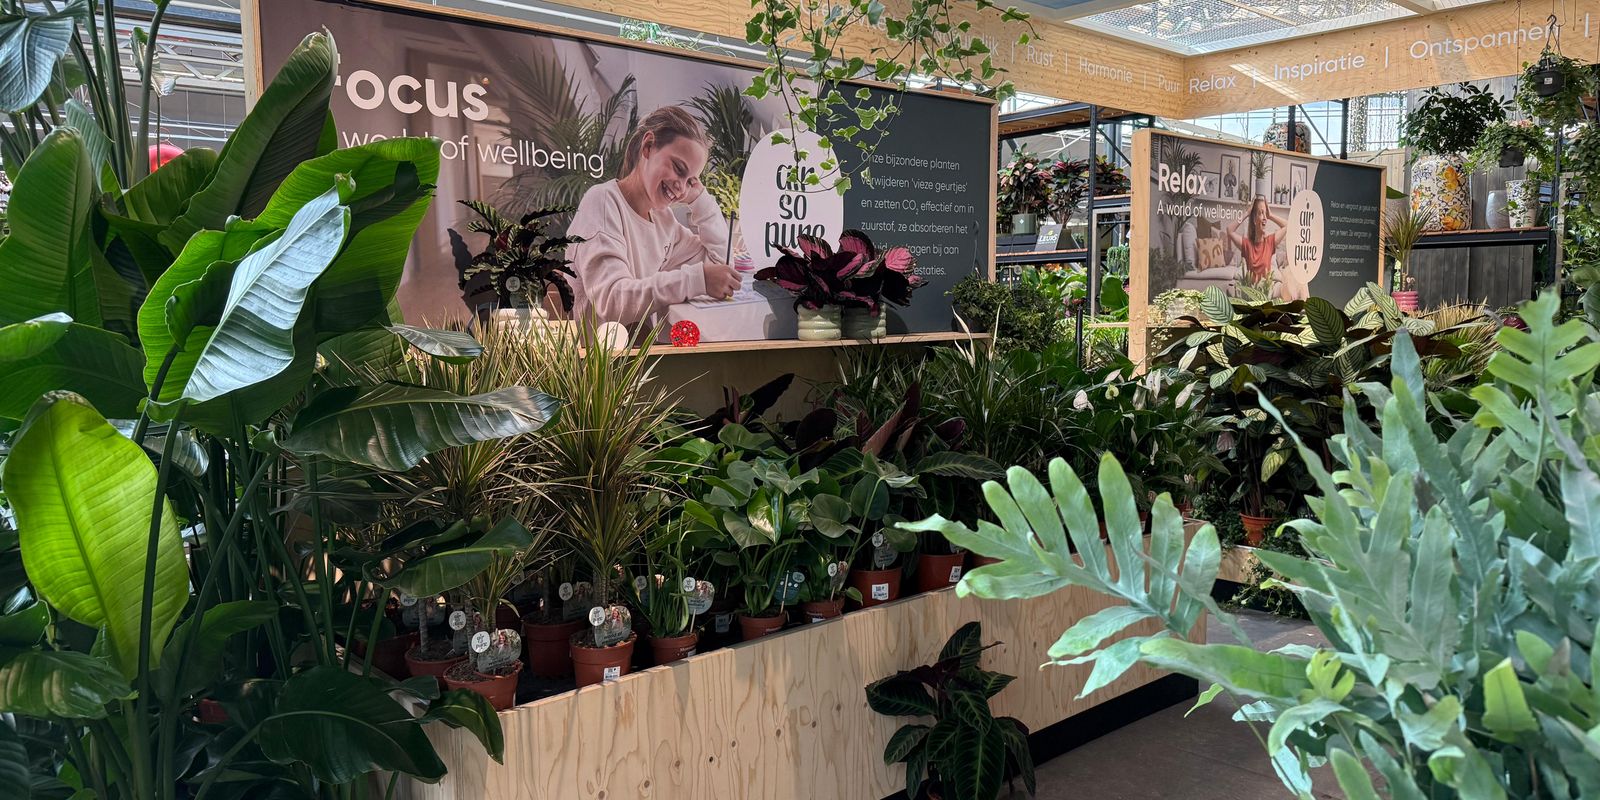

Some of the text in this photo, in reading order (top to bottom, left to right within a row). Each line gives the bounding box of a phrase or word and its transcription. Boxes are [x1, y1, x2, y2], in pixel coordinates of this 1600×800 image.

[1027, 44, 1054, 67] Rust
[1079, 56, 1134, 84] Harmonie
[1158, 74, 1181, 93] Puur
[1189, 23, 1559, 94] Relax Inspiratie Ontspannen
[335, 53, 489, 121] ocus
[440, 135, 469, 161] of
[477, 140, 604, 178] wellbeing
[885, 153, 929, 168] bijzondere
[929, 158, 960, 170] planten
[911, 178, 934, 190] 'vieze
[935, 182, 968, 194] geurtjes'
[1158, 162, 1207, 195] Relax
[779, 194, 807, 220] so
[861, 199, 872, 208] en
[874, 200, 900, 210] zetten
[920, 201, 953, 213] effectief
[954, 204, 966, 214] om
[967, 204, 975, 214] in
[1156, 199, 1243, 224] A world of wellbeing
[861, 220, 968, 234] zuurstof, ze absorberen het
[1299, 211, 1315, 227] air
[1300, 228, 1311, 244] so
[905, 243, 931, 256] ragen
[932, 244, 942, 256] bij
[943, 247, 959, 255] aan
[1294, 244, 1317, 266] pure
